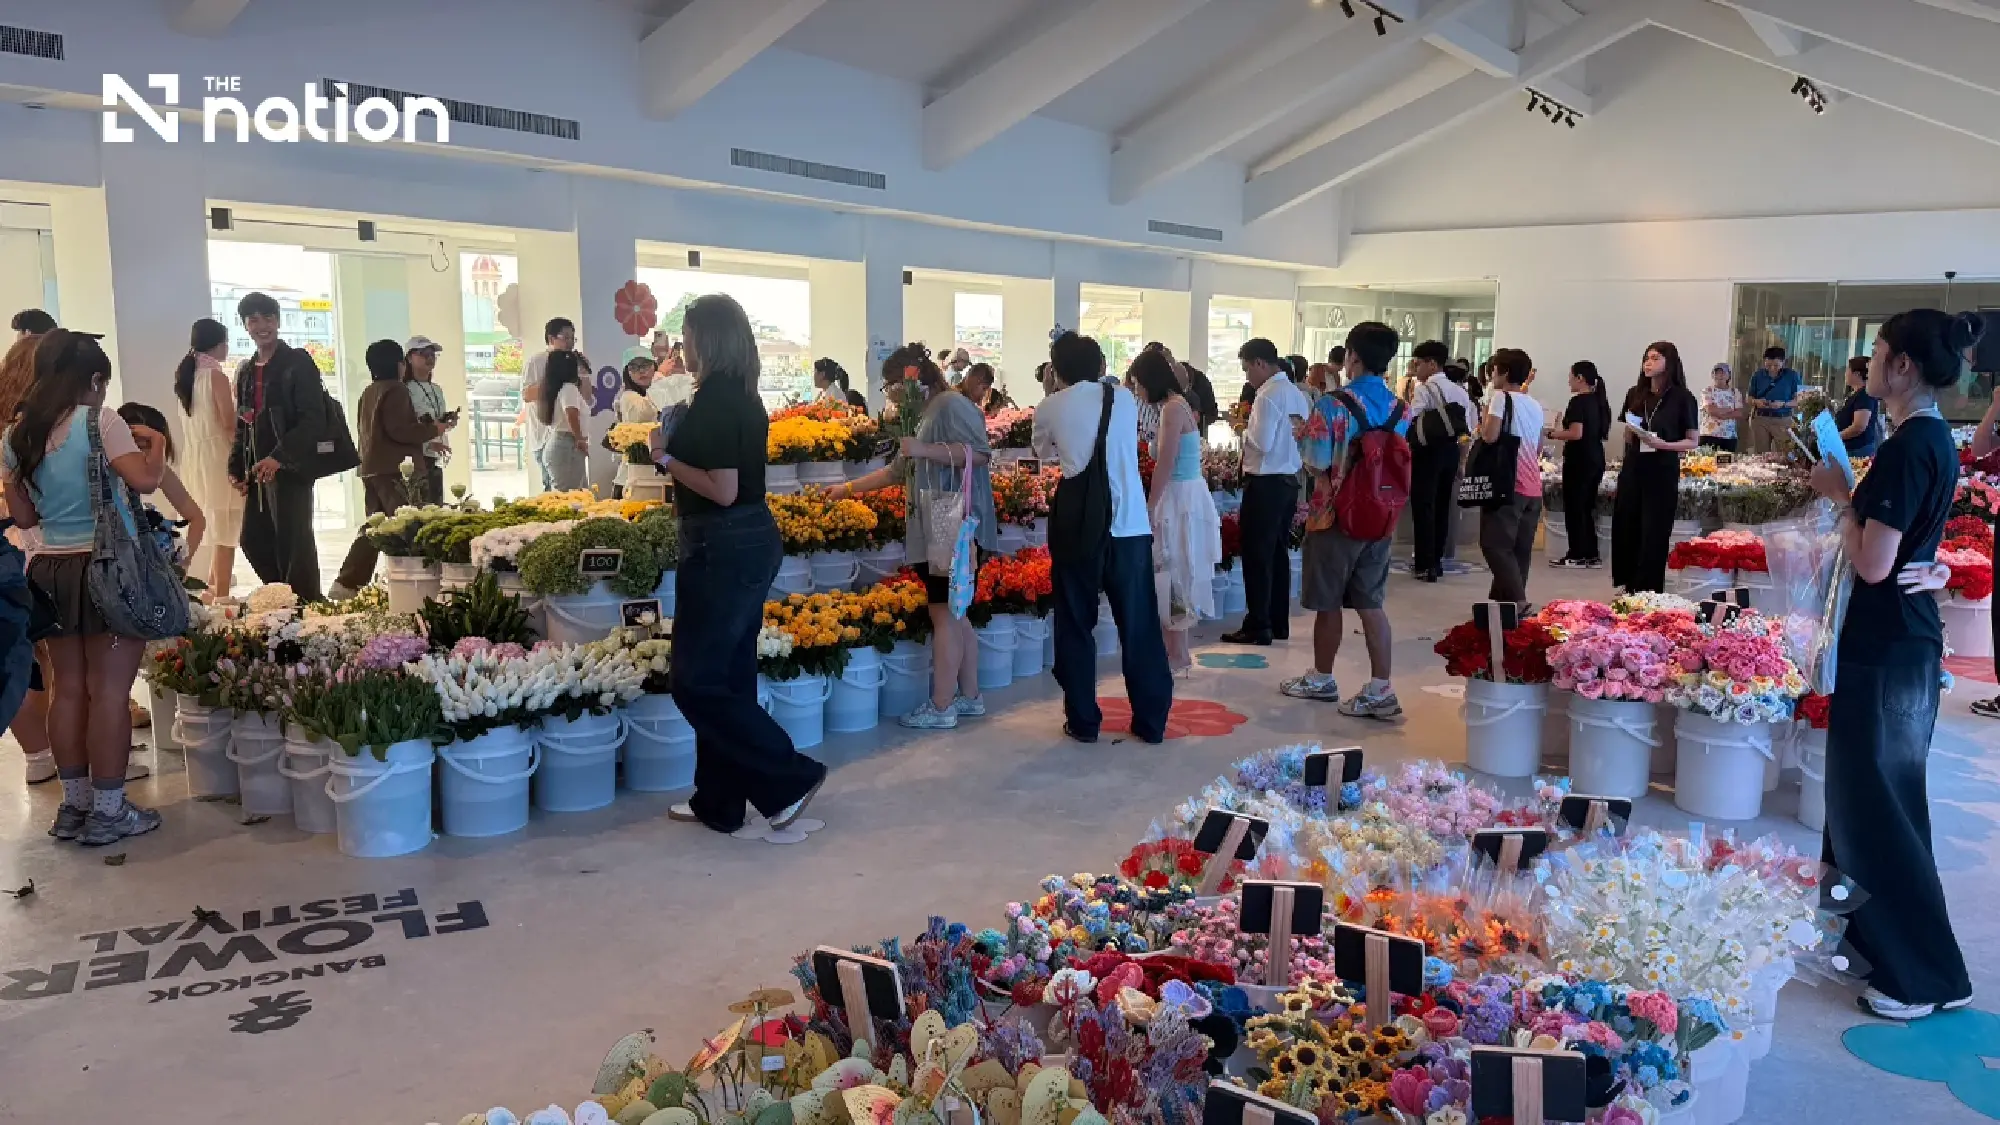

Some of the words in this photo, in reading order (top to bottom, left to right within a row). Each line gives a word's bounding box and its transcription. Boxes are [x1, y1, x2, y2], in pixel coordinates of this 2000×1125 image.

[0, 899, 490, 1000] FLOWER
[79, 887, 419, 954] FESTIVAL
[148, 953, 387, 1004] BANGKOK
